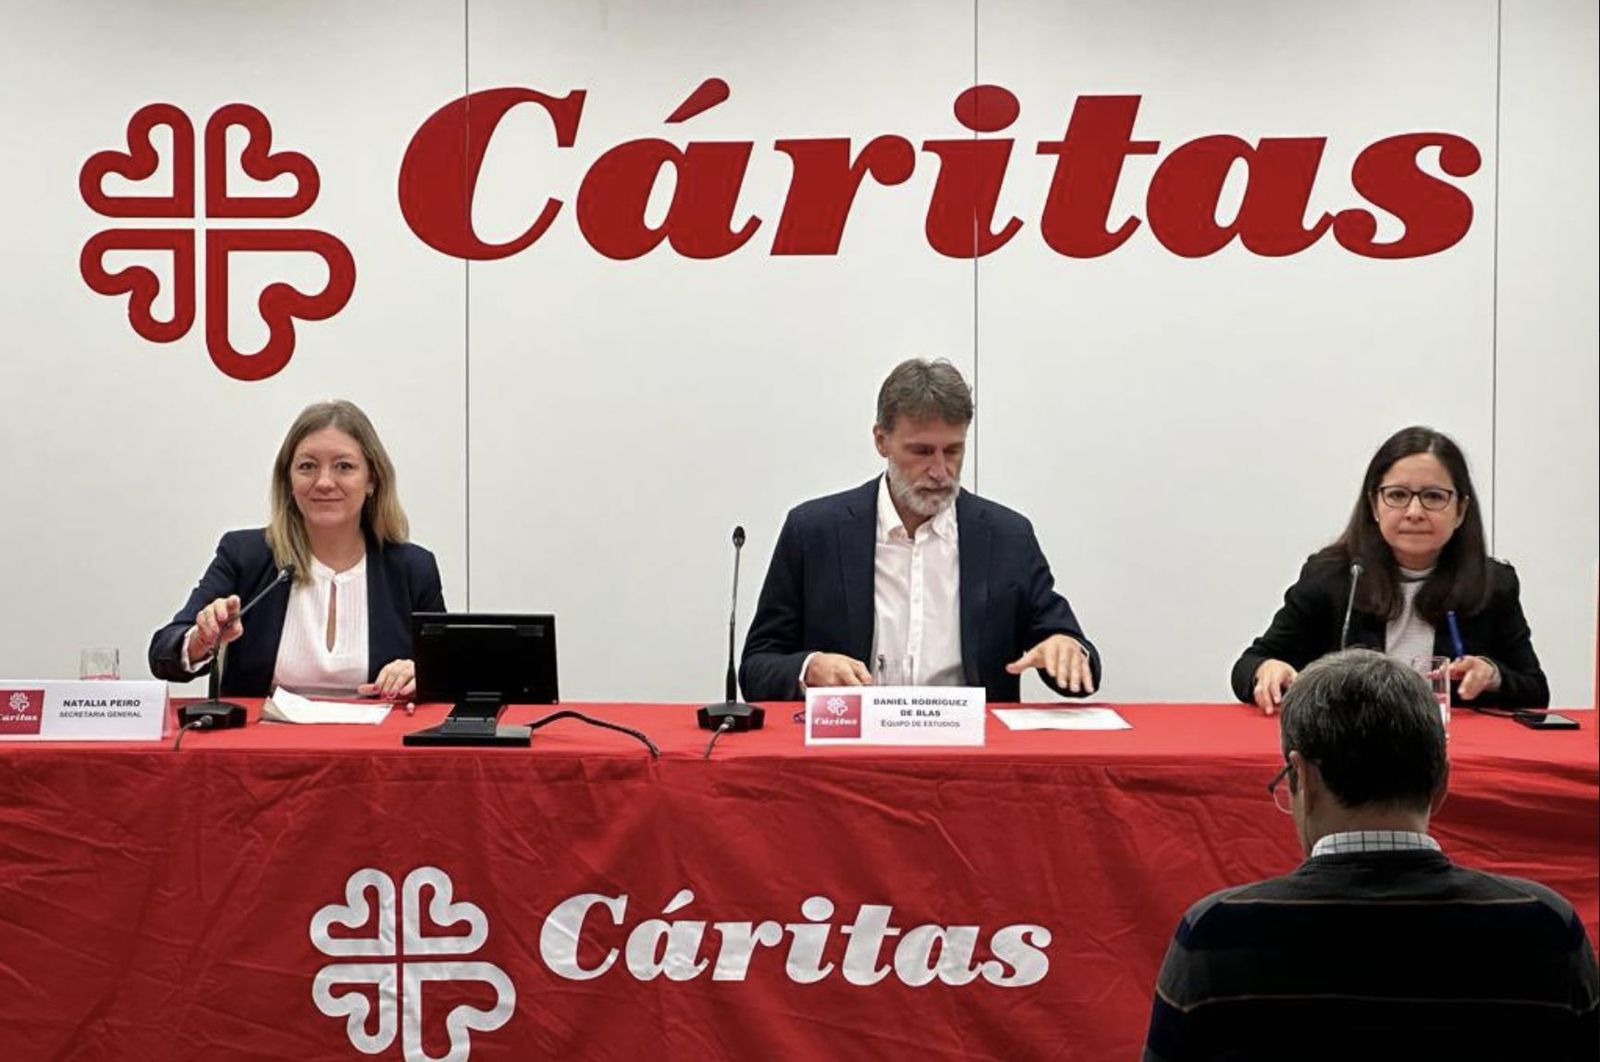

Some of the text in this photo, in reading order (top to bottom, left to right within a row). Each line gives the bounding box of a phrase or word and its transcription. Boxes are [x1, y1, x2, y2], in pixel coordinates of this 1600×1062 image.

[398, 78, 1481, 261] Cáritas
[63, 699, 107, 707] NATALIA
[873, 698, 908, 706] DANIEL
[900, 709, 941, 717] DE BLAS
[881, 719, 910, 727] EQUIPO
[923, 720, 961, 728] ESTUDIOS
[539, 889, 1052, 987] Cáritas
